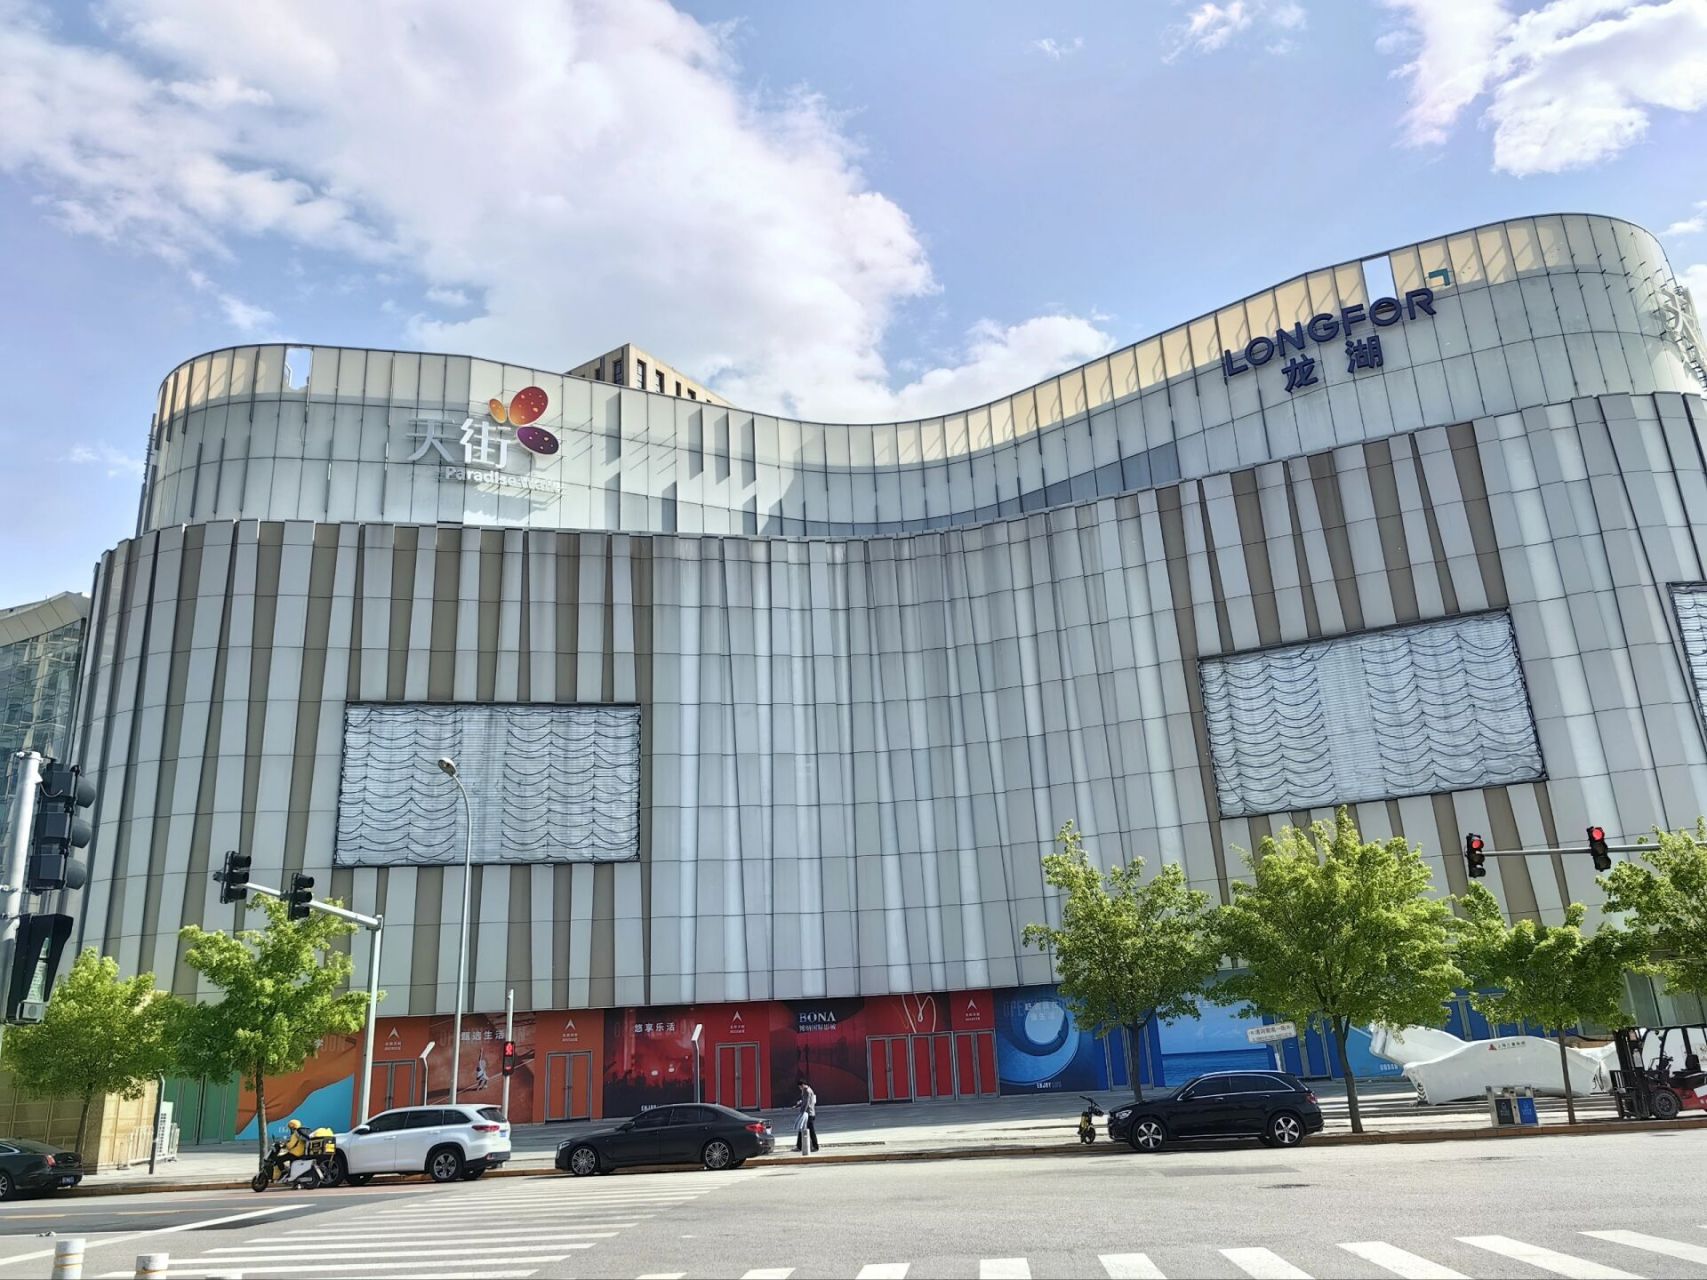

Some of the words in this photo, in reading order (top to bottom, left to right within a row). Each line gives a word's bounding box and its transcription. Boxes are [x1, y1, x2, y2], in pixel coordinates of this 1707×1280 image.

[1224, 287, 1437, 377] LONGFOR
[1281, 335, 1384, 393] 龙湖
[406, 417, 513, 469] 天街
[445, 466, 519, 487] Paradise
[799, 1010, 836, 1023] BONA
